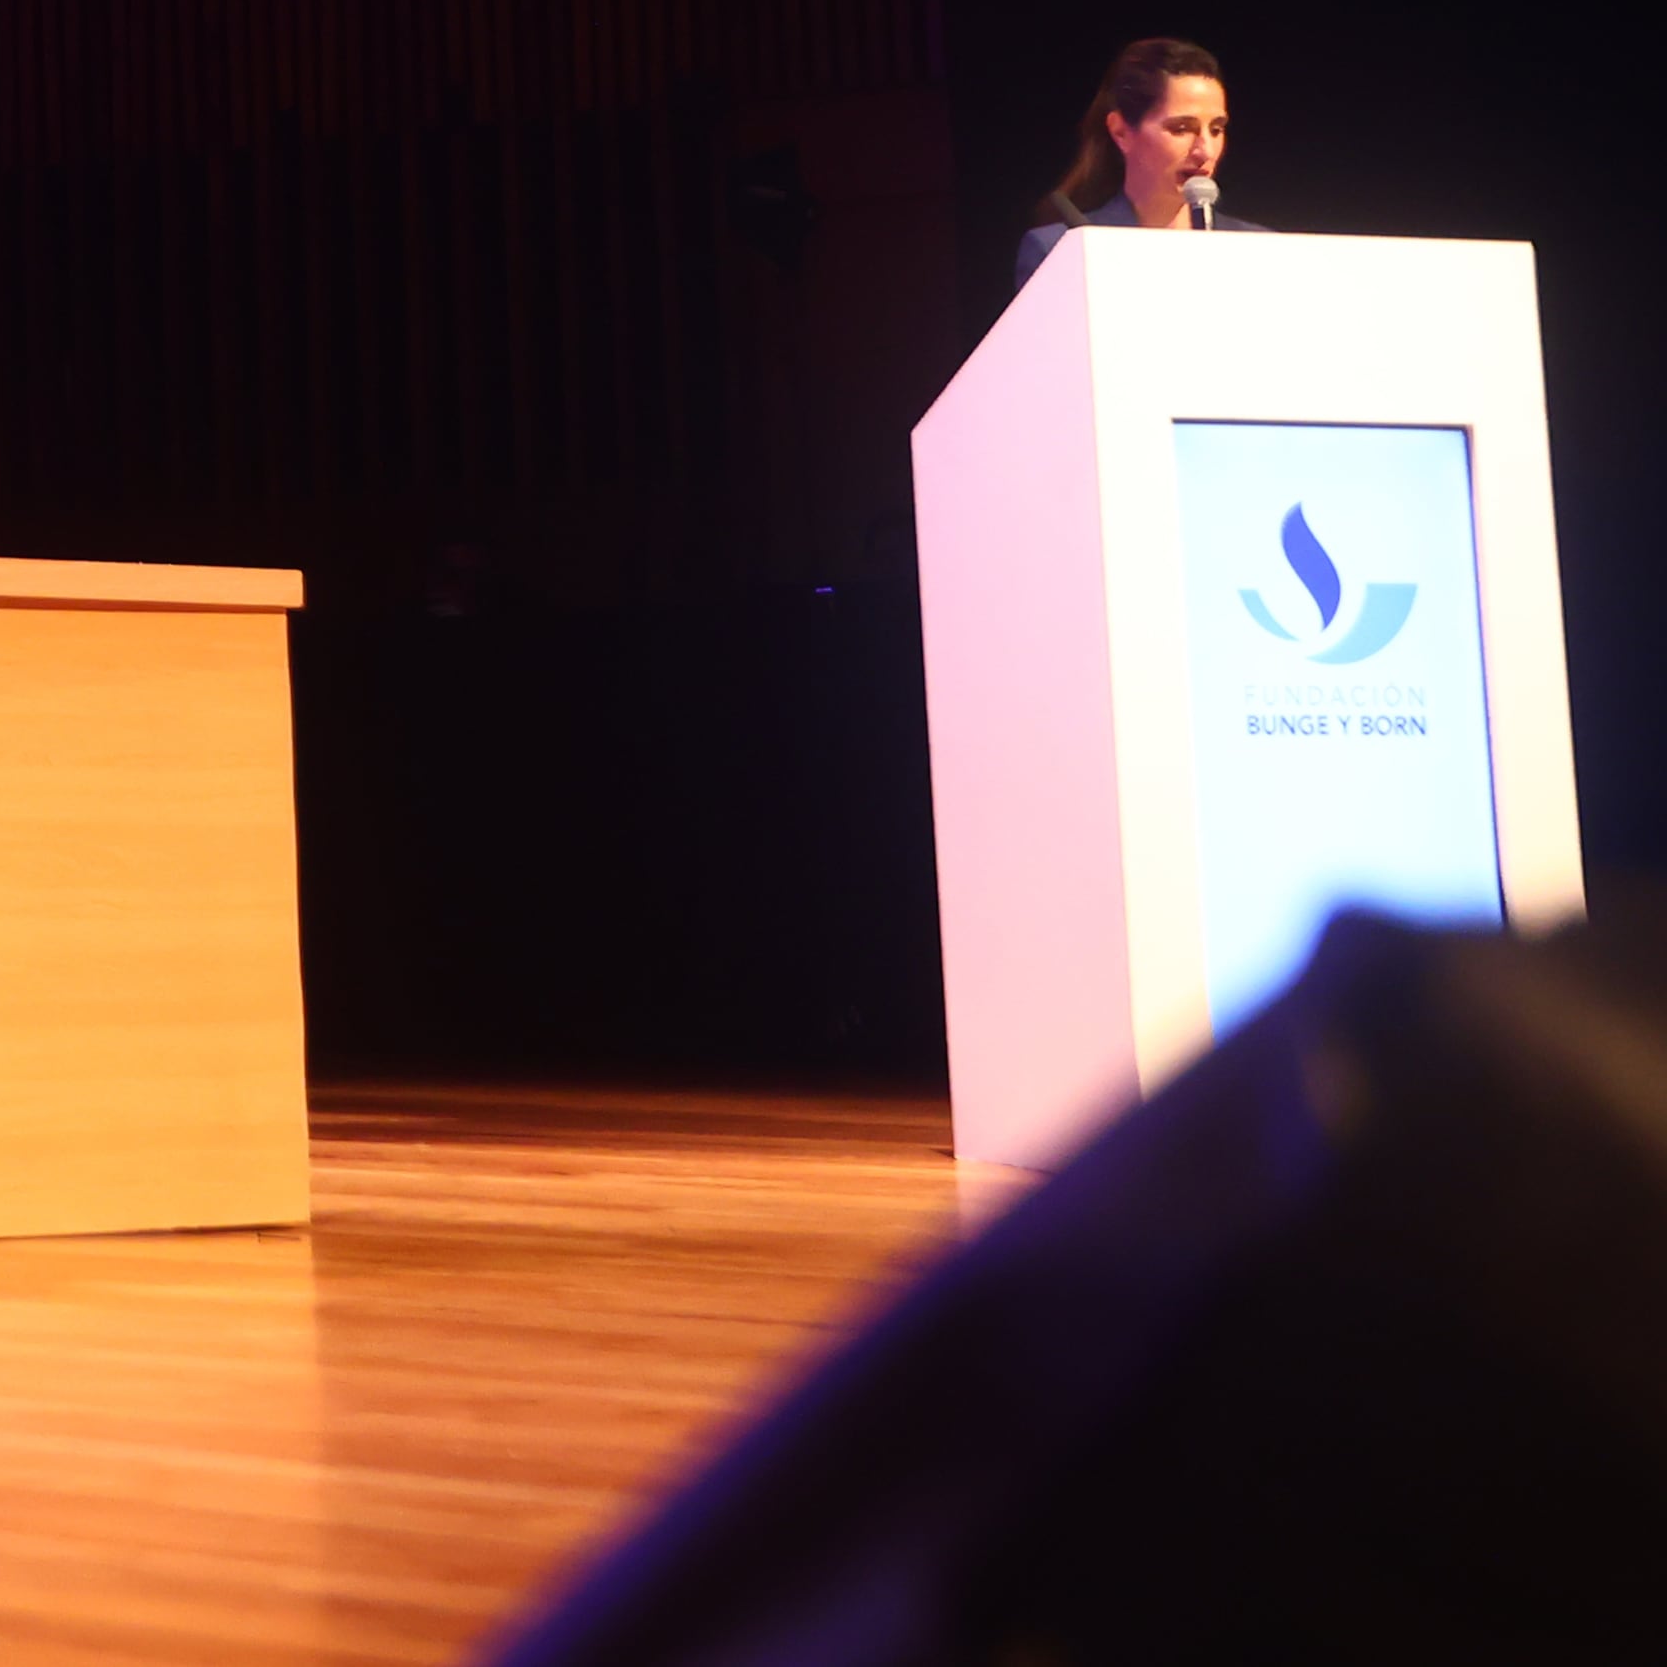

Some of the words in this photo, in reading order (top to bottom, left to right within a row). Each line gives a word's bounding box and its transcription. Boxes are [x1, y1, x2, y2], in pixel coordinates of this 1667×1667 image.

[1244, 680, 1428, 708] FUNDACIÓN
[1246, 715, 1330, 736] BUNGE
[1336, 715, 1352, 736] Y
[1360, 715, 1429, 736] BORN
